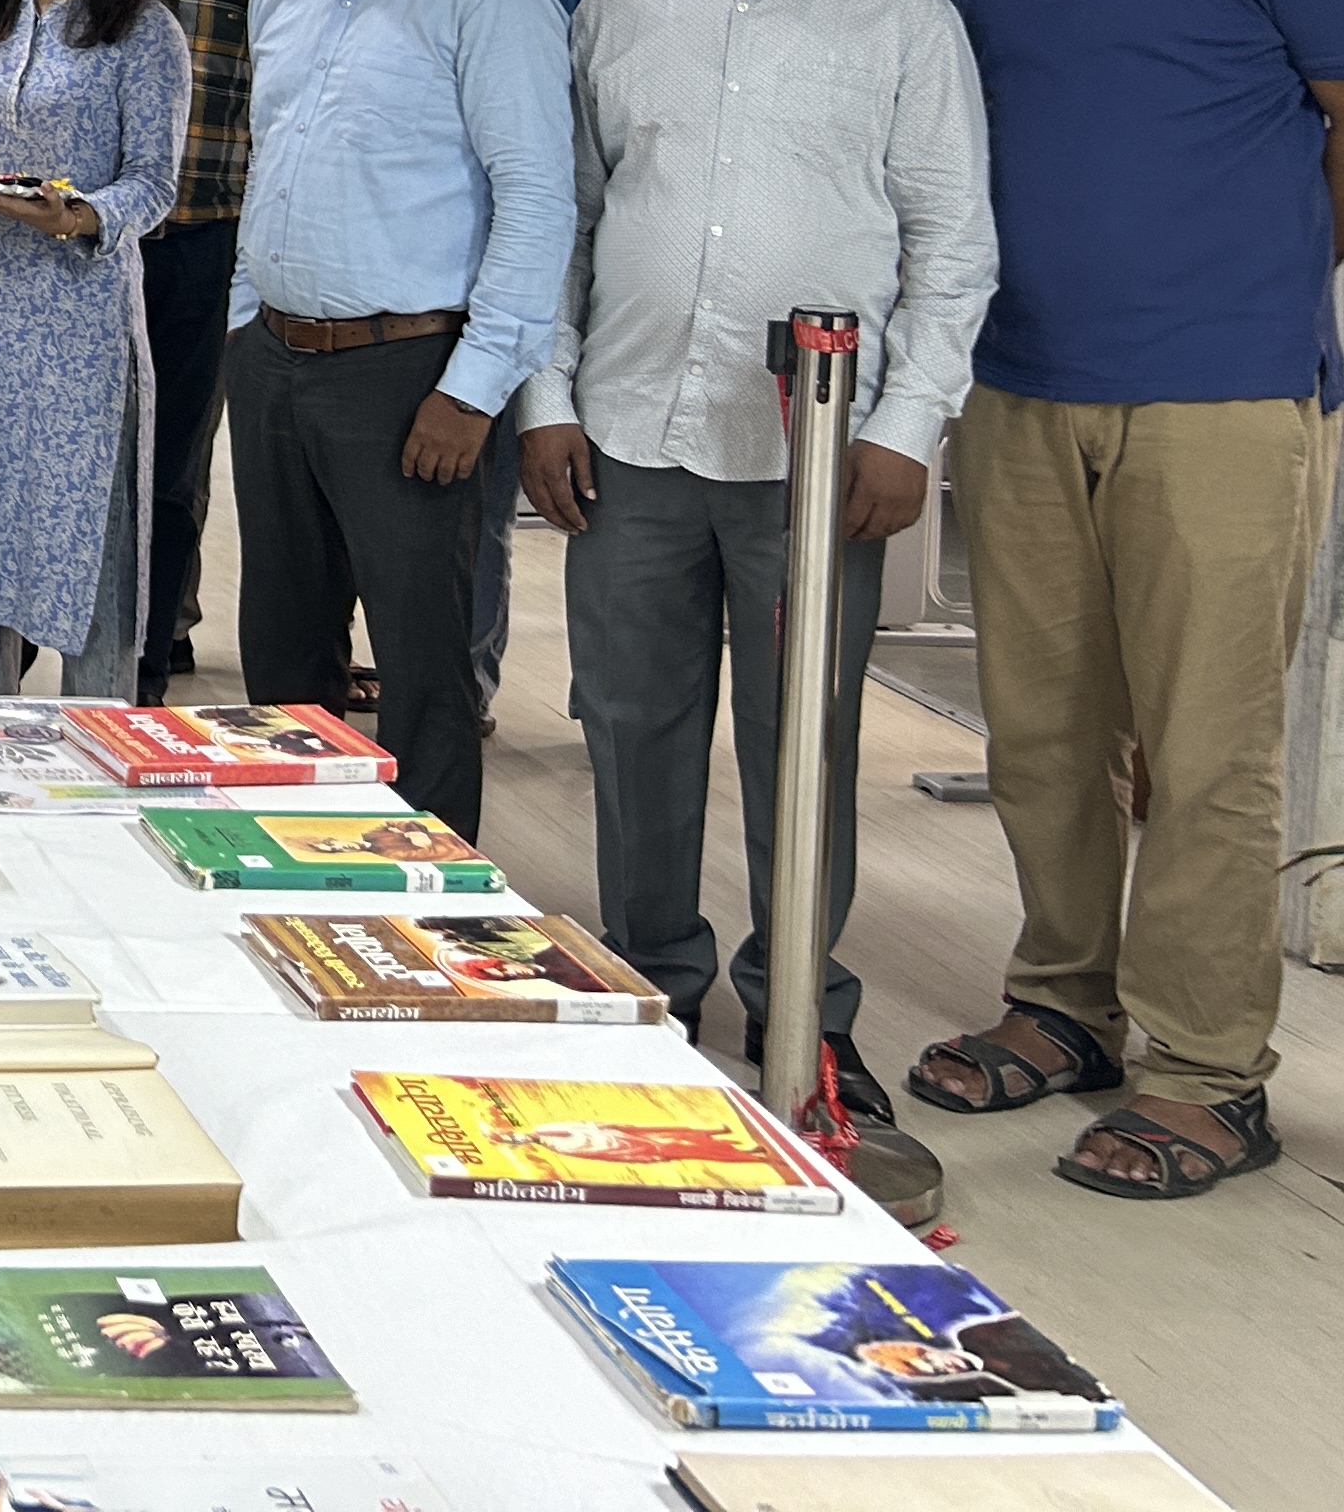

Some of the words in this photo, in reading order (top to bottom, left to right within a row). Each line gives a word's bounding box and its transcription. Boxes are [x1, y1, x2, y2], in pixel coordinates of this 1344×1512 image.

[328, 922, 412, 980] राजयोग
[338, 1002, 420, 1021] राजयोग
[396, 1076, 483, 1165] भक्तियोग
[473, 1178, 588, 1202] भक्तियोग
[172, 1300, 215, 1331] कैसे
[210, 1298, 247, 1324] हम
[611, 1284, 718, 1376] कर्मयोग
[764, 1407, 871, 1429] कर्मयोग
